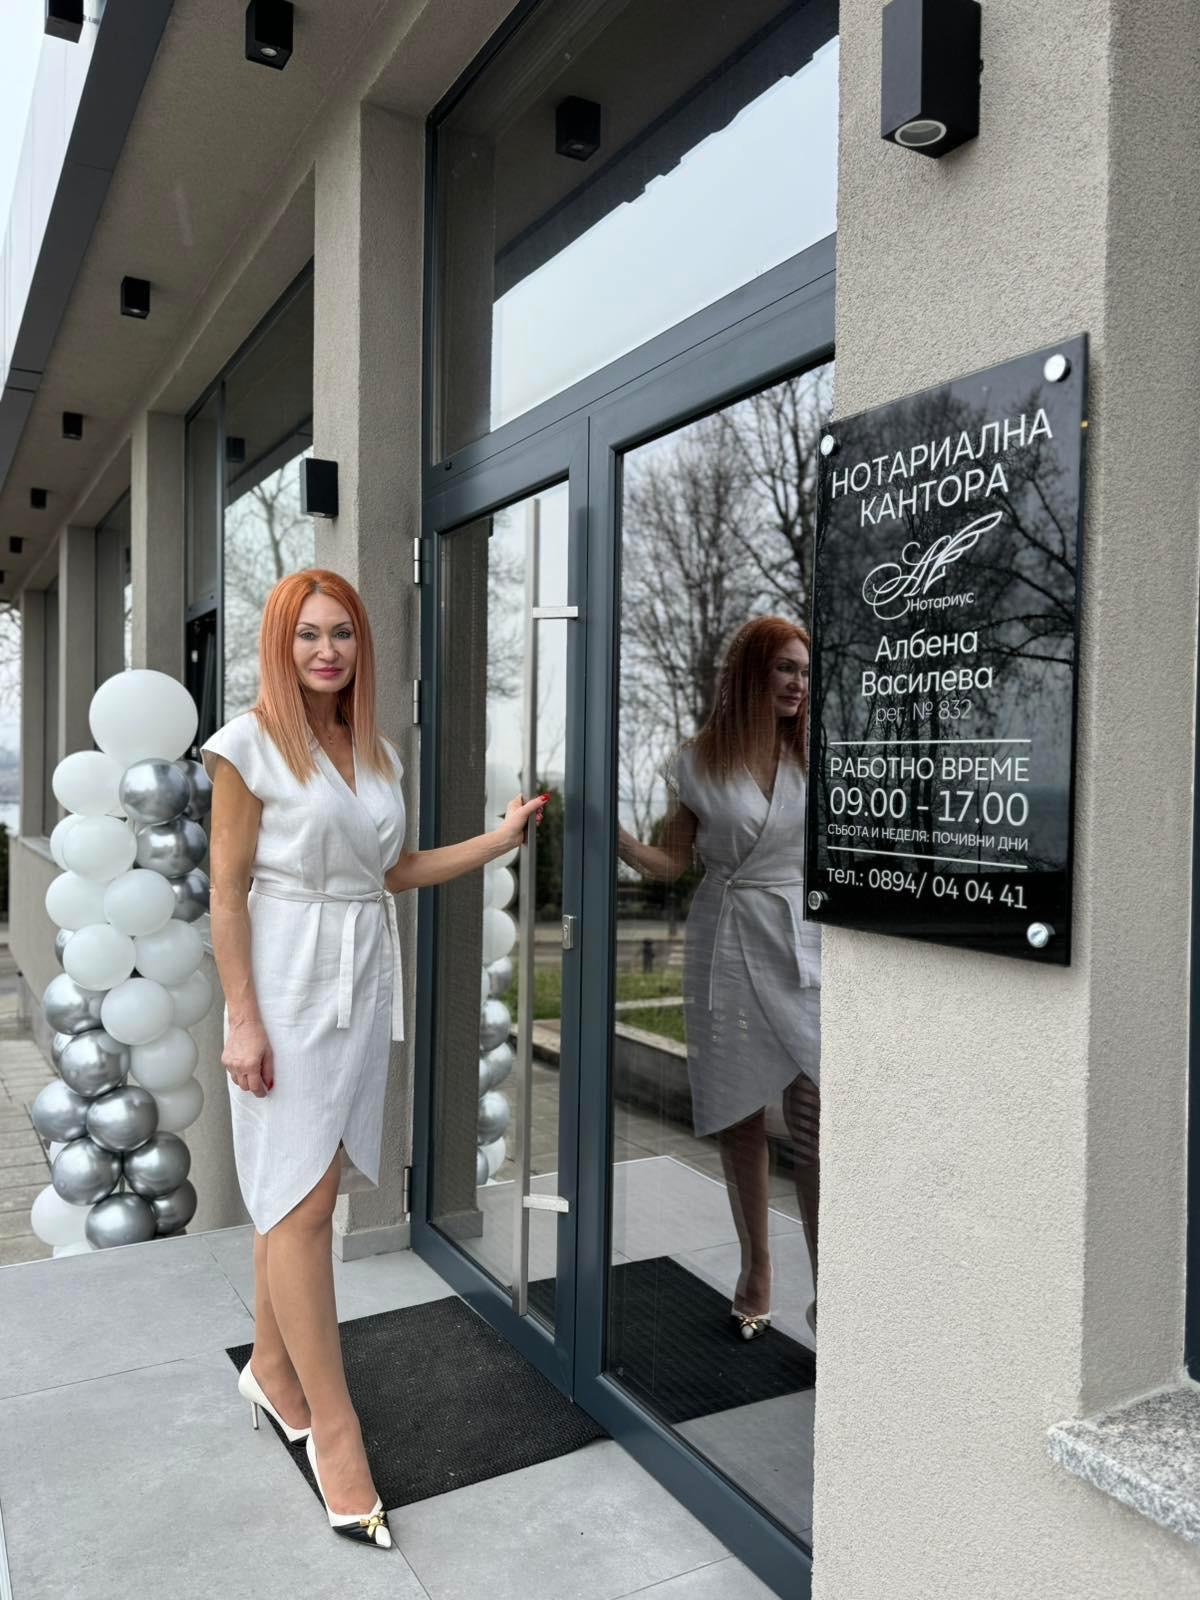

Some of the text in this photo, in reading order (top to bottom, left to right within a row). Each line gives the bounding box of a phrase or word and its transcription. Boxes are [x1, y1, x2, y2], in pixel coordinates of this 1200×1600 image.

[831, 408, 1053, 499] НОТАРИАЛНА
[860, 462, 1010, 528] КАНТОРА
[910, 592, 975, 612] Нотариус
[874, 628, 978, 663] Албена
[861, 666, 994, 697] Василева
[876, 706, 908, 725] рег.
[938, 699, 973, 720] 832
[830, 757, 1030, 782] РАБОТНО ВРЕМЕ
[830, 786, 907, 819] 09.00
[938, 790, 1030, 827] 17.00
[827, 823, 1029, 852] СЪБОТА И НЕДЕЛЯ: ПОЧИВНИ ДНИ
[826, 867, 1028, 910] тел.: 0894/ 04 04 41
